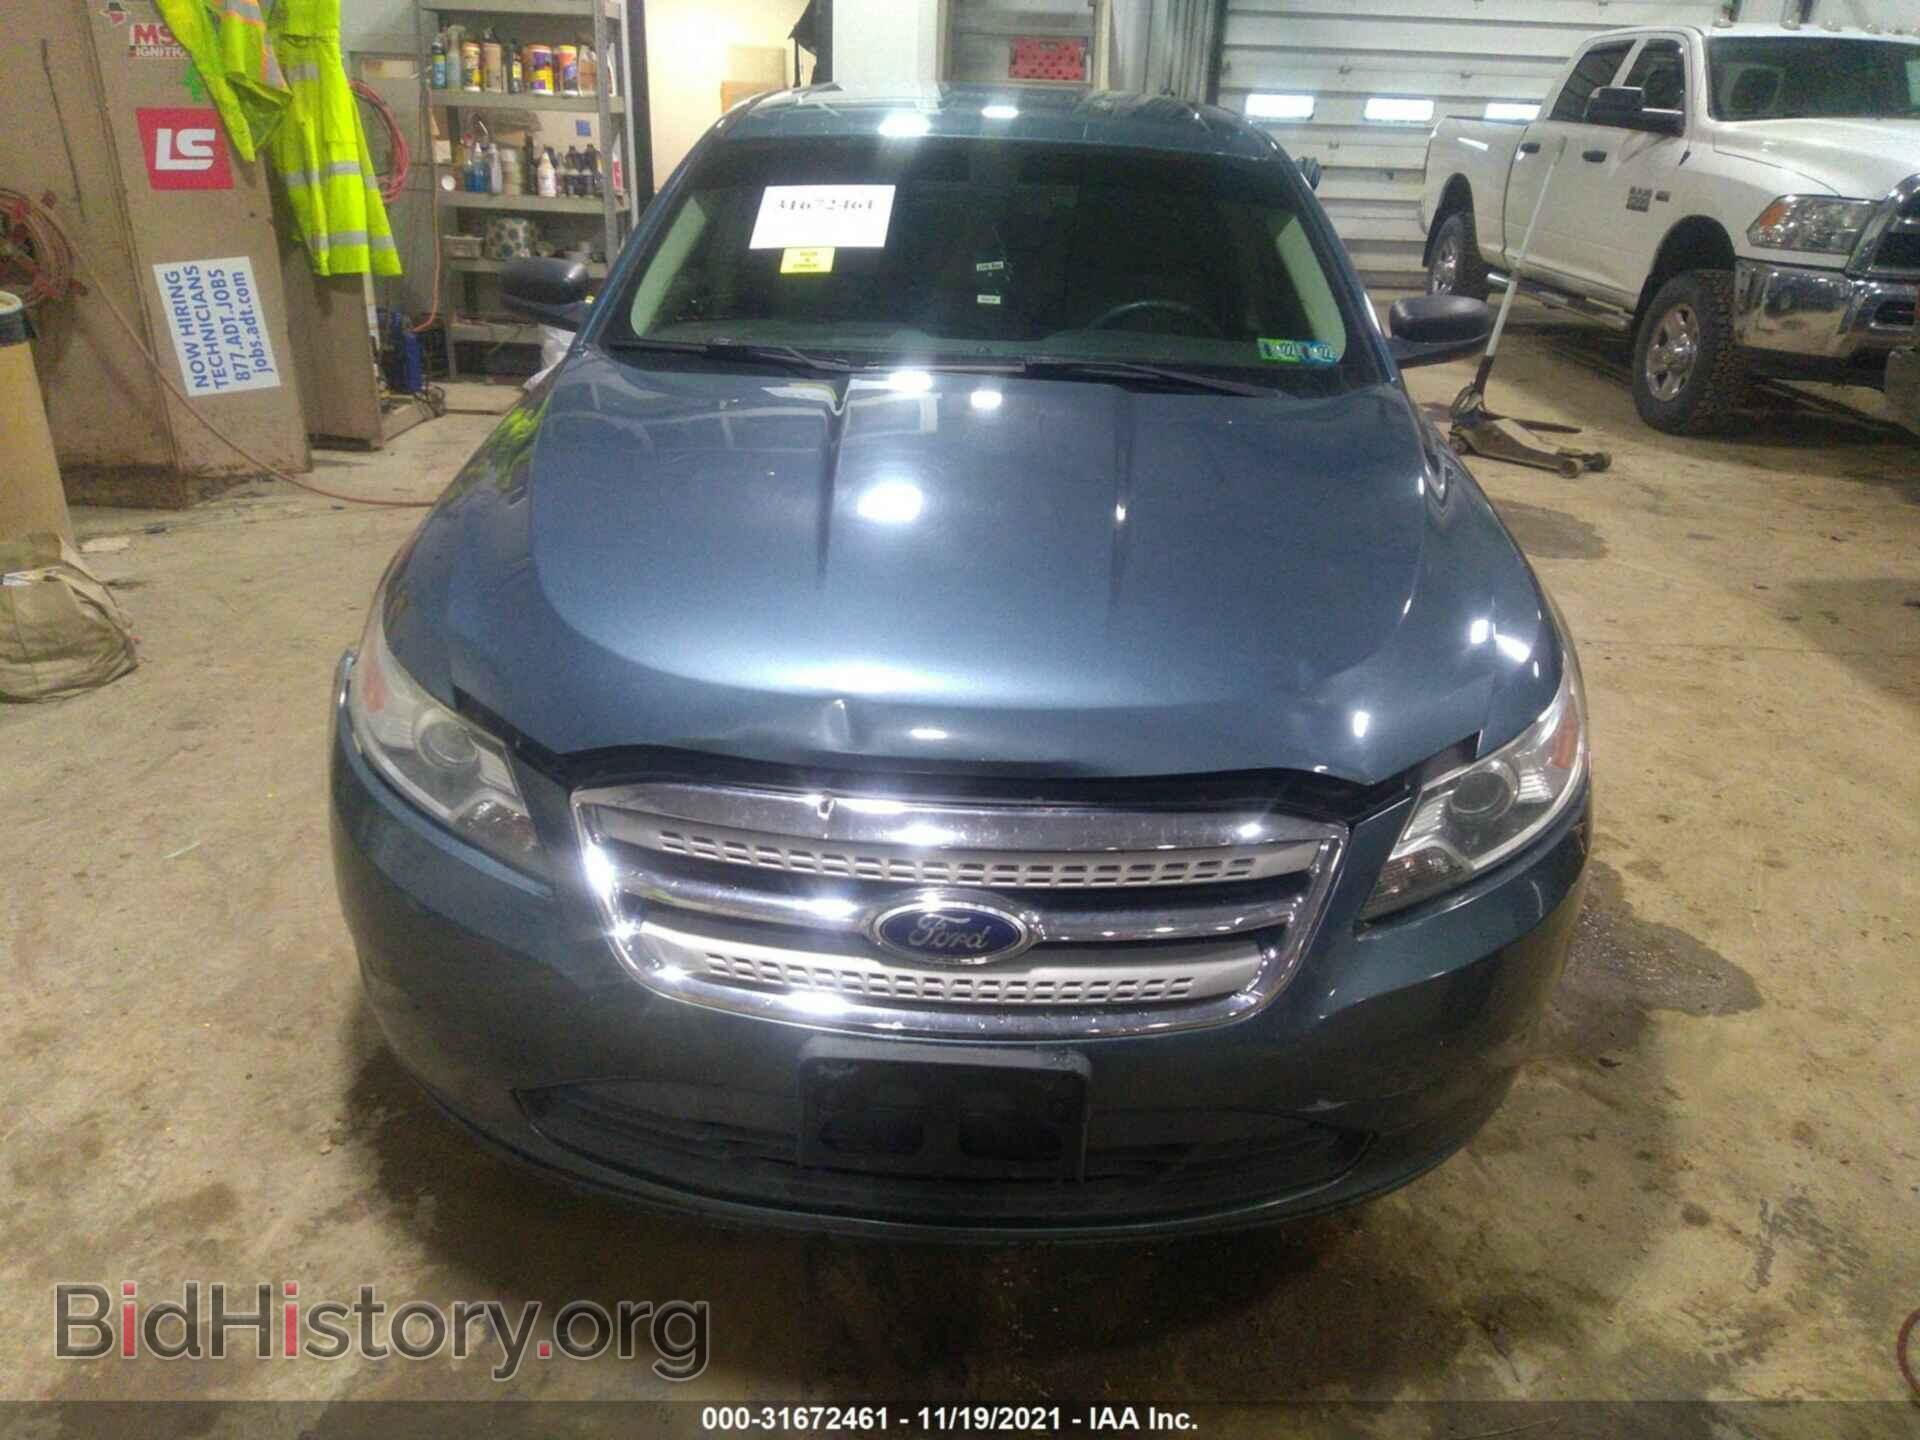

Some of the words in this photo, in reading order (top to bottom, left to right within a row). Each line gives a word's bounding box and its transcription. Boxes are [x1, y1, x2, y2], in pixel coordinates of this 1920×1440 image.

[130, 24, 178, 46] MS
[135, 45, 188, 57] IGNITIO
[154, 128, 216, 171] LS
[165, 271, 196, 336] HIRING
[208, 269, 251, 380] 877.ADT.JOBS
[232, 271, 274, 373] jobs.adt.com
[184, 265, 229, 389] TECHNICIANS
[184, 342, 209, 388] NOW
[908, 913, 992, 949] Ford
